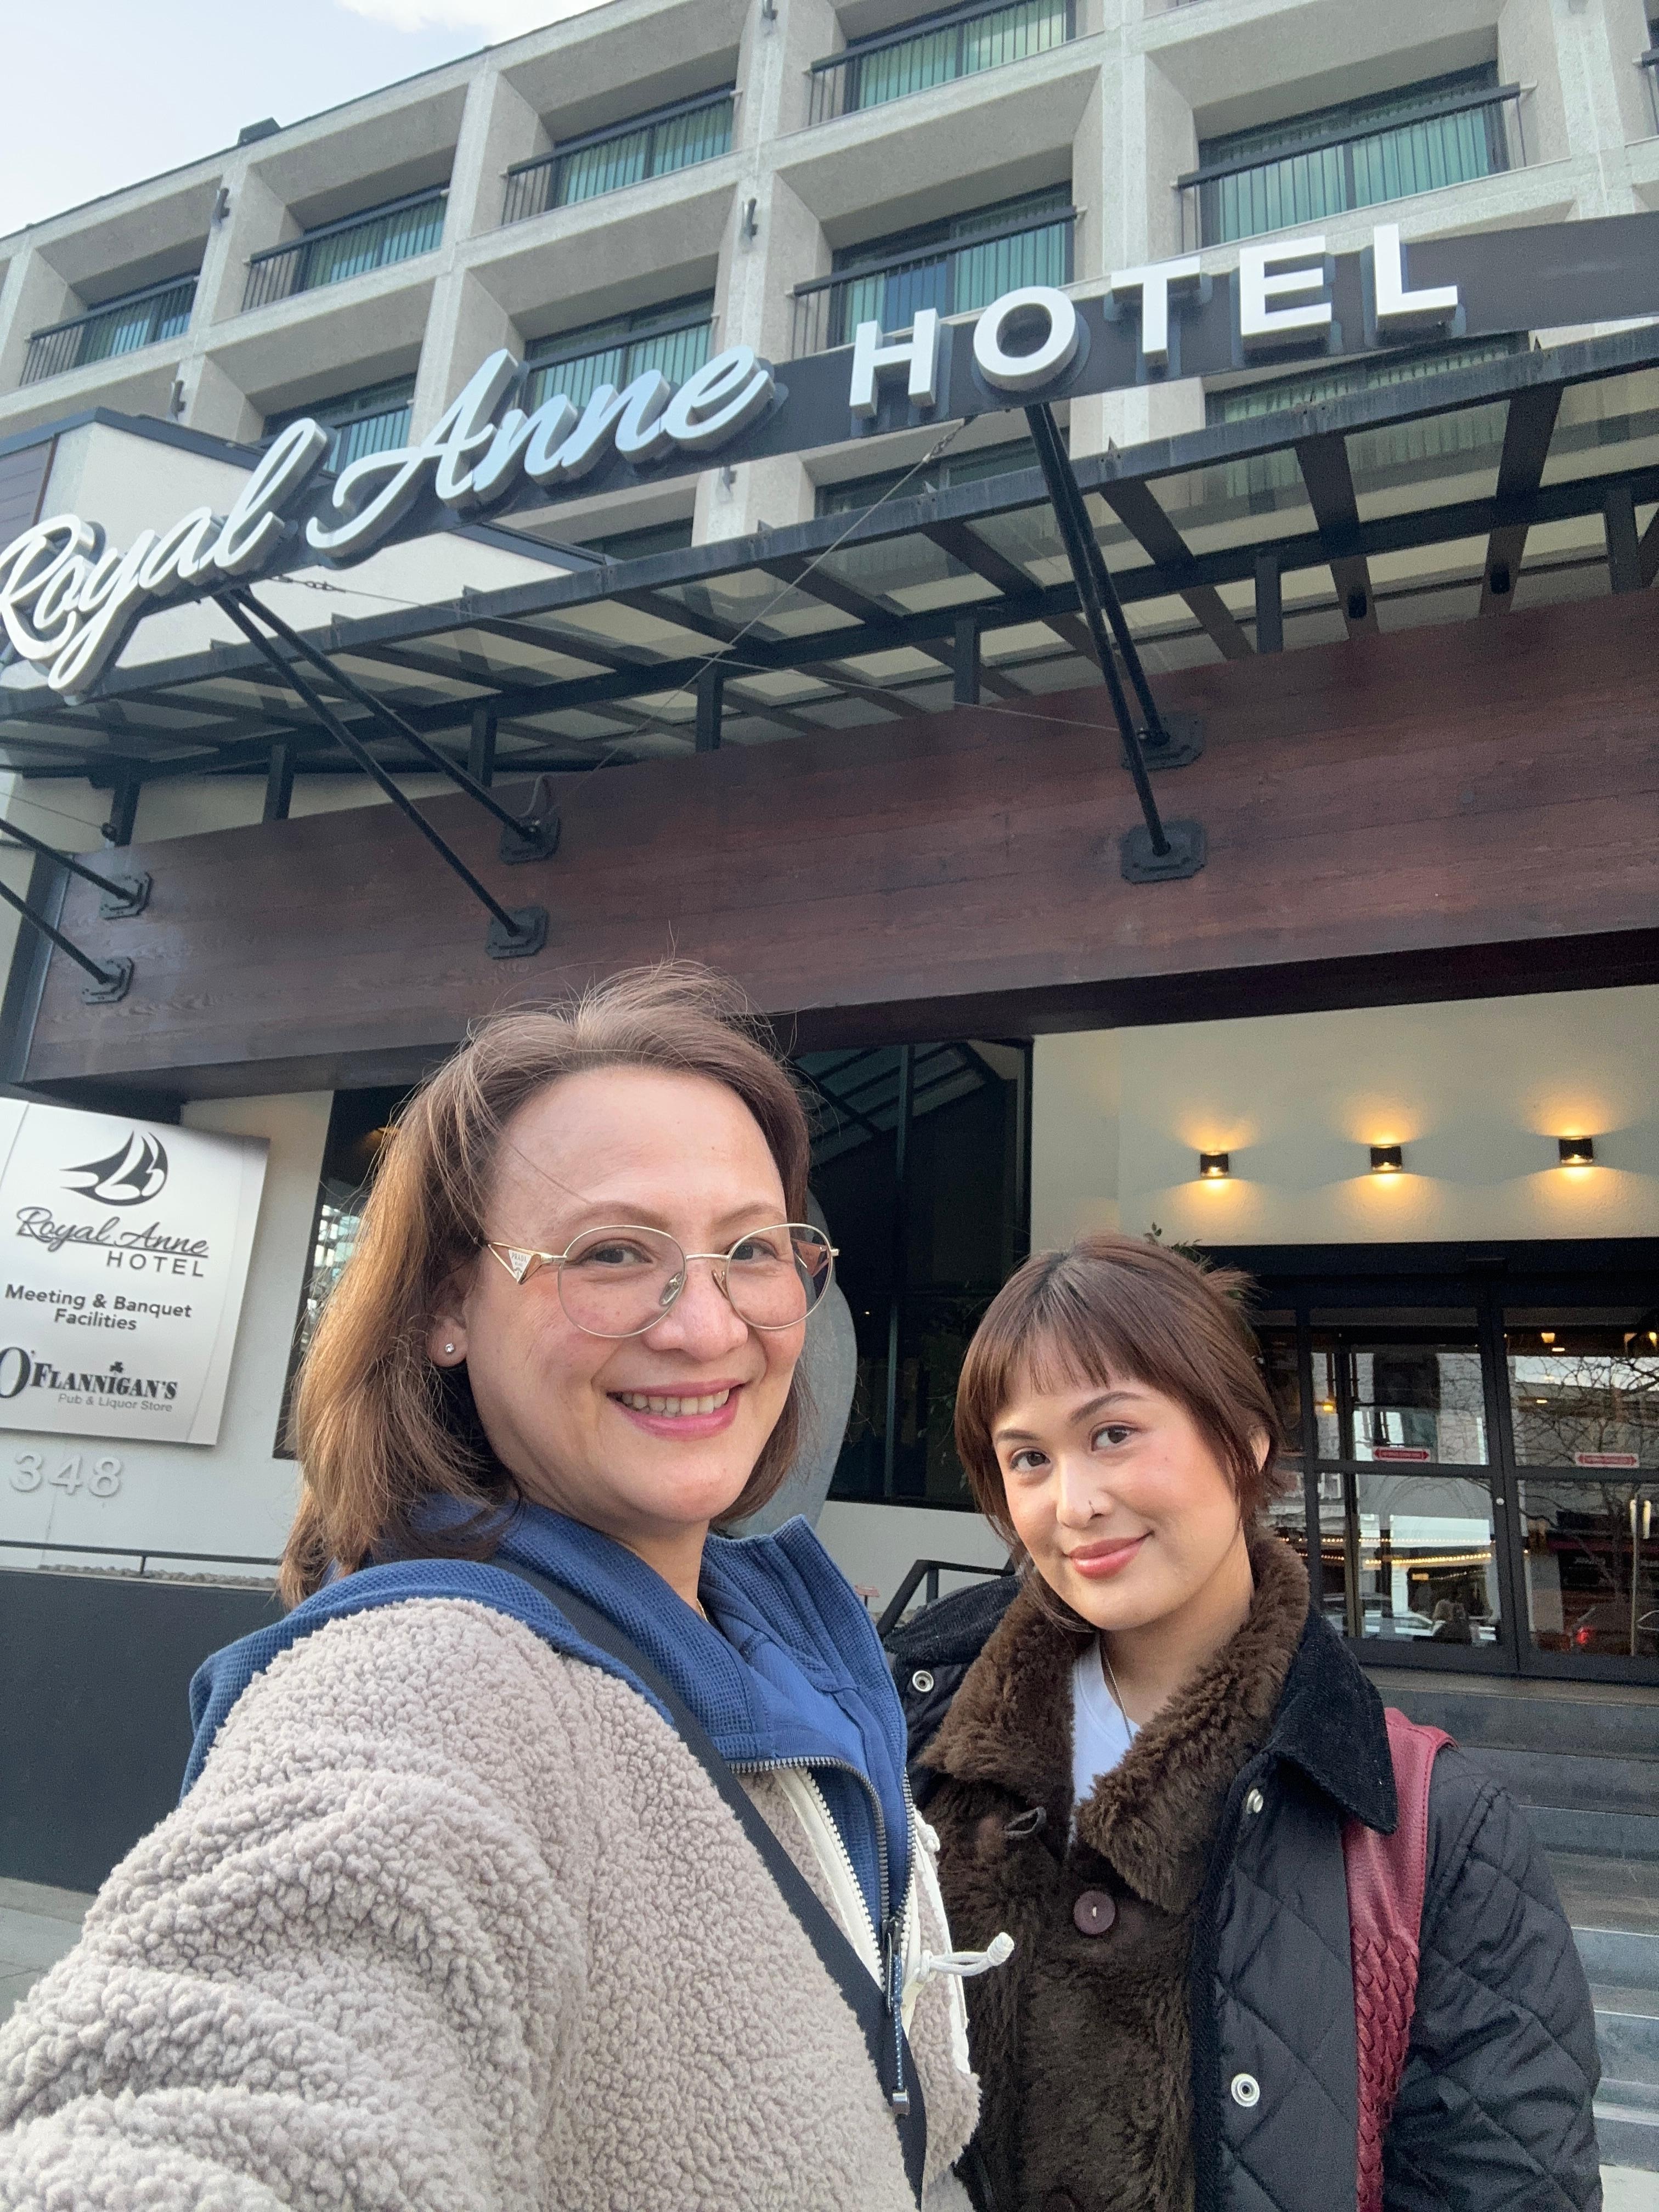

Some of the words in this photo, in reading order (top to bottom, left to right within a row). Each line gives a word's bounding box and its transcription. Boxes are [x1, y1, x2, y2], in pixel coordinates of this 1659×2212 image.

[0, 417, 323, 690] Royal
[306, 345, 772, 550] Anne
[849, 223, 1459, 415] HOTEL
[16, 1206, 120, 1252] Royal
[114, 1221, 208, 1255] Anne
[106, 1250, 204, 1277] HOTEL
[511, 1252, 527, 1262] PRADA
[4, 1283, 86, 1310] Meeting
[92, 1293, 107, 1309] &
[114, 1296, 192, 1318] Banquet
[54, 1308, 137, 1330] Facilities
[58, 1393, 81, 1404] Pub
[86, 1396, 94, 1406] &
[99, 1397, 137, 1410] Liquor
[141, 1400, 173, 1412] Store
[9, 1452, 123, 1498] 348
